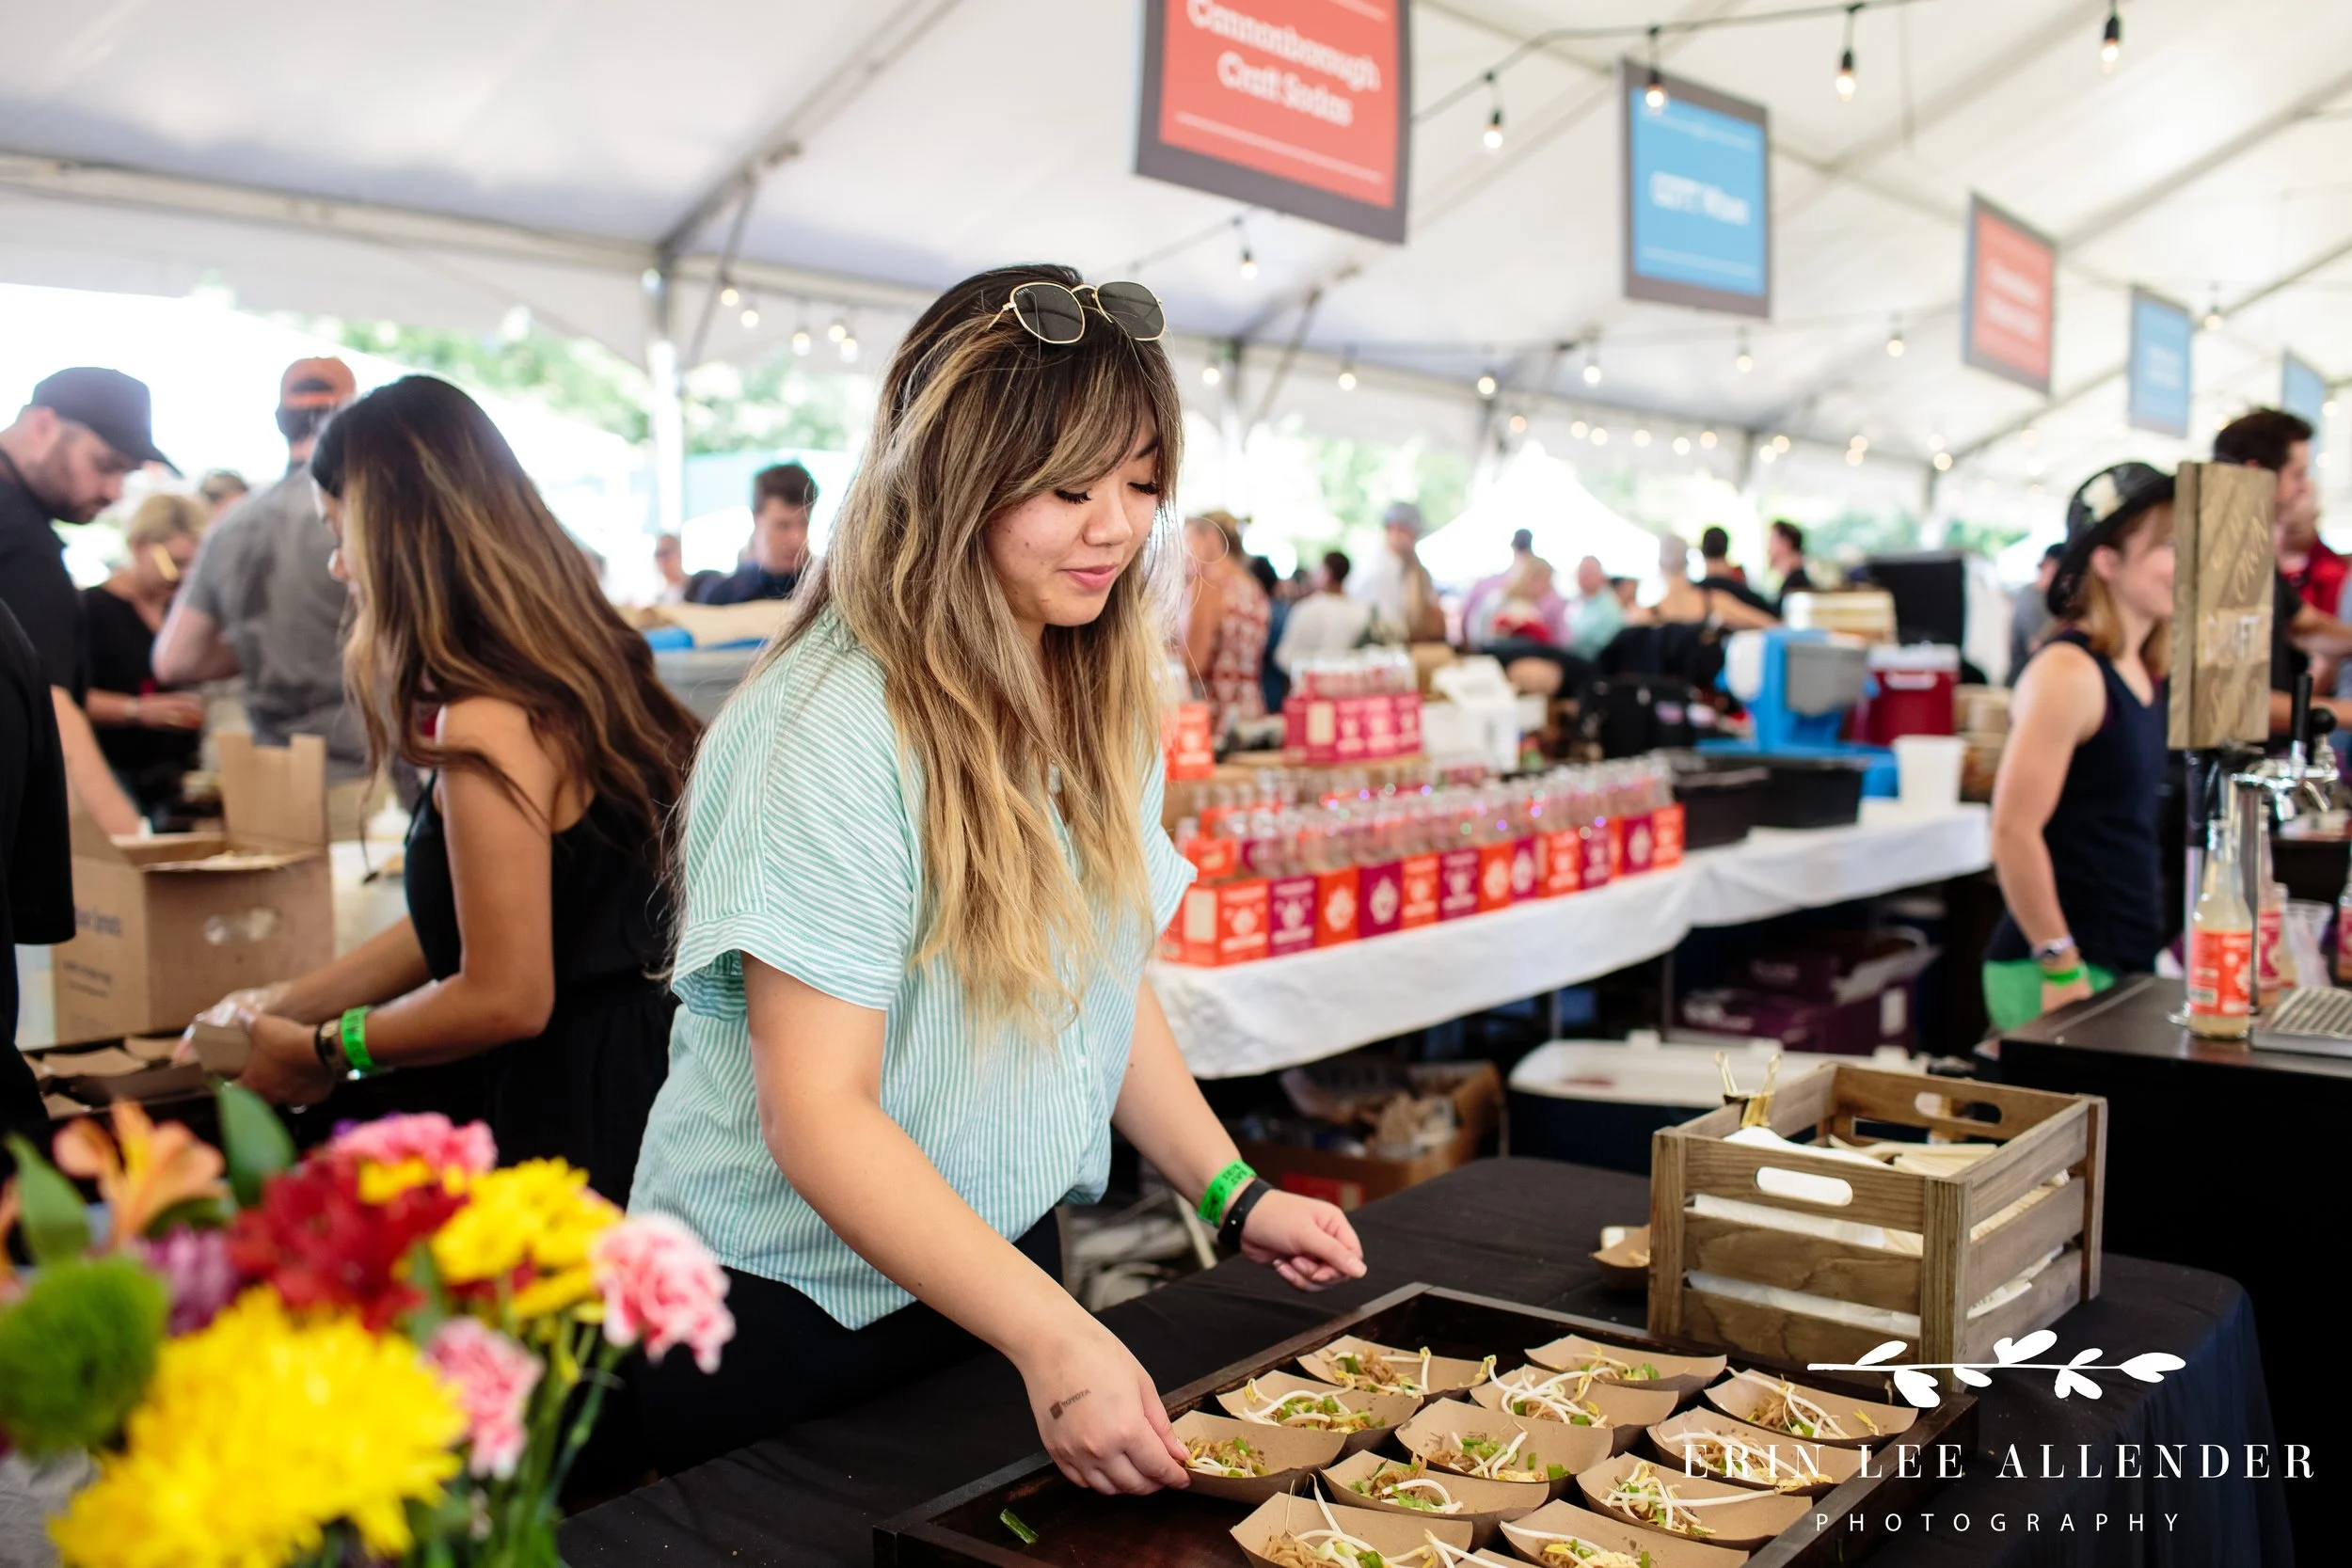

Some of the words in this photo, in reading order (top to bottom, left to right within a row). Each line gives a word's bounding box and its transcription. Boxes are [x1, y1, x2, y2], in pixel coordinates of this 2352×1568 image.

[1186, 0, 1381, 92] Cannonborough
[1217, 51, 1283, 103] Craft
[1282, 71, 1354, 127] Sodas
